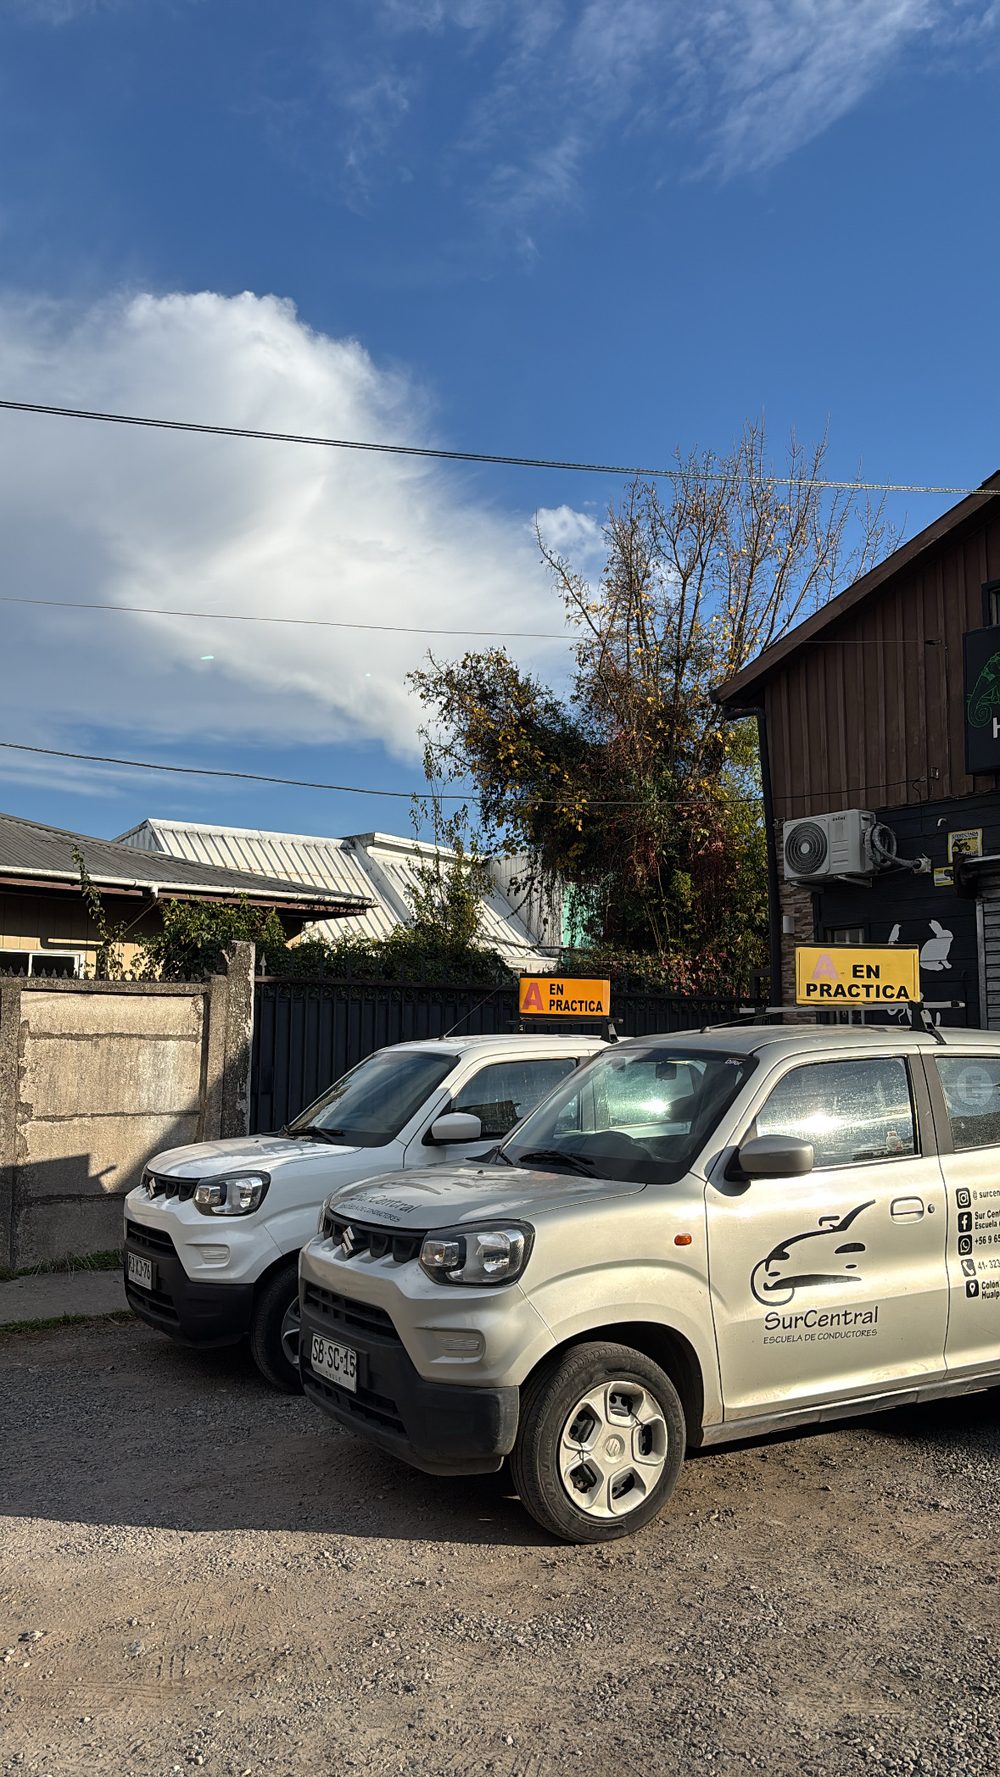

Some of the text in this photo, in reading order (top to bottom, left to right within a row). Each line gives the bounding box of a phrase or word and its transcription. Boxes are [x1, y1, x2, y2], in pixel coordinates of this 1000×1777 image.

[812, 954, 880, 980] A EN
[521, 982, 564, 1011] A EN
[806, 983, 910, 1000] PRACTICA
[549, 999, 604, 1013] PRACTICA
[974, 1211, 986, 1221] Sur
[974, 1220, 998, 1230] Escuela
[975, 1235, 987, 1246] +56
[988, 1234, 993, 1244] 9
[764, 1305, 879, 1331] SurCentral
[763, 1328, 878, 1345] ESCUELA DE CONDUCTORES
